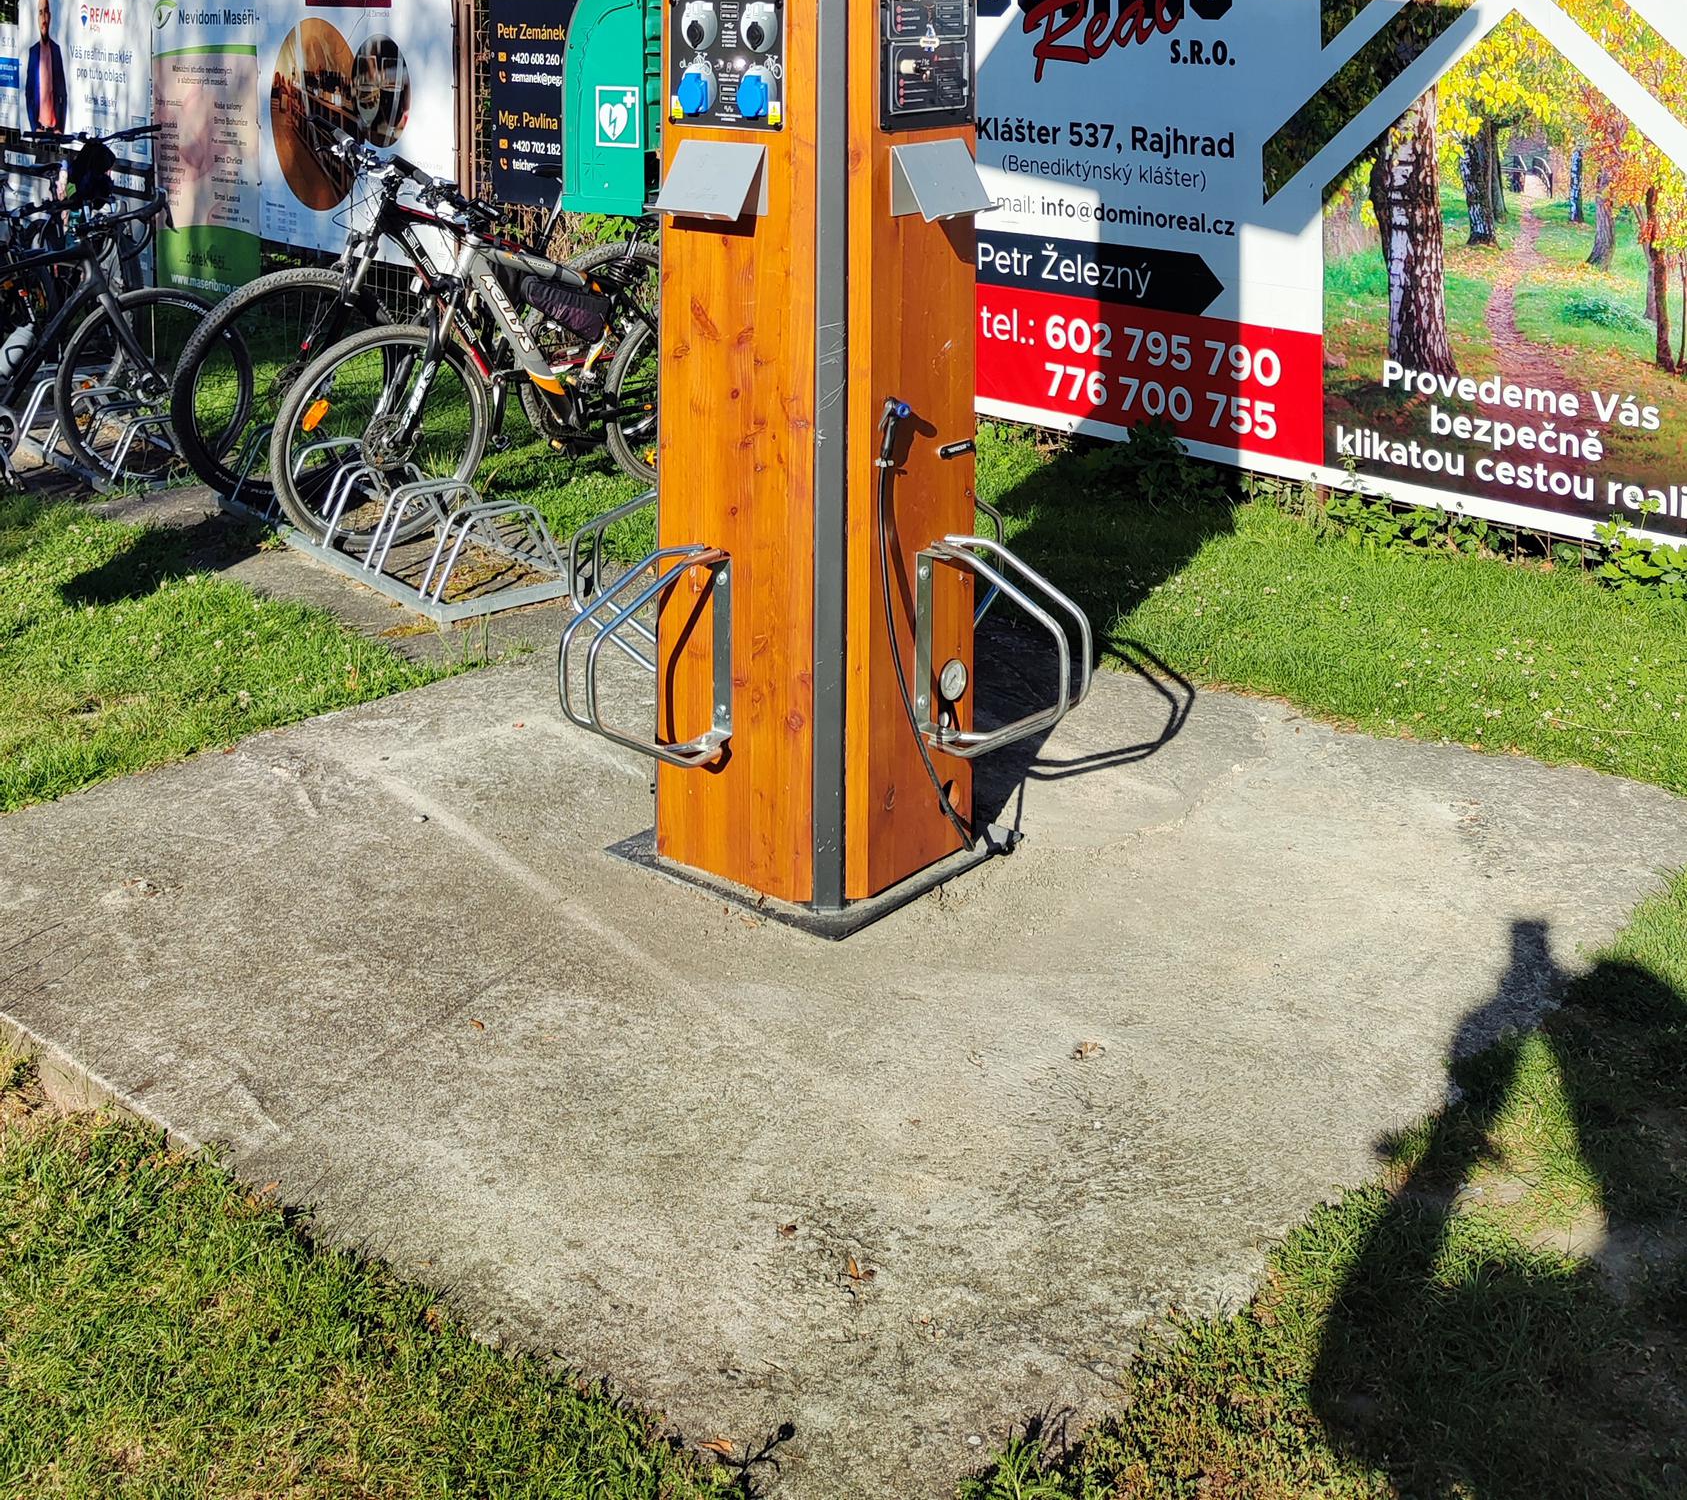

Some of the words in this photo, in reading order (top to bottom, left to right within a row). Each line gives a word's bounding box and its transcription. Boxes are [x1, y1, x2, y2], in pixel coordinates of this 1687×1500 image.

[90, 7, 122, 24] RE/MAX
[178, 8, 221, 26] Nevidomí
[223, 8, 254, 26] Maséři
[497, 23, 518, 39] Petr
[520, 24, 565, 40] Zemánek
[70, 45, 82, 59] Váš
[108, 47, 132, 64] makléř
[511, 52, 530, 65] +420
[530, 54, 544, 65] 608
[546, 54, 560, 66] 260
[1170, 39, 1235, 65] S.R.O.
[76, 68, 87, 80] pro
[104, 69, 126, 83] oblast
[499, 110, 520, 129] Mgr.
[523, 112, 558, 130] Pavlína
[512, 140, 530, 153] +420
[531, 142, 545, 154] 702
[546, 143, 561, 155] 182
[977, 117, 1060, 145] Klášter
[1069, 122, 1123, 153] 537,
[1131, 127, 1234, 159] Rajhrad
[1001, 154, 1132, 186] (Benediktýnský
[1139, 168, 1206, 192] klášter)
[1041, 196, 1235, 237] info@dominoreal.cz
[977, 242, 1032, 277] Petr
[1041, 243, 1151, 298] Železný
[981, 305, 1035, 345] tel.:
[1045, 315, 1112, 358] 602
[1123, 327, 1192, 371] 795
[1204, 340, 1281, 387] 790
[1044, 362, 1108, 405] 776
[1118, 376, 1193, 422] 700
[1206, 391, 1277, 440] 755
[1382, 359, 1579, 417] Provedeme
[1591, 390, 1661, 430] Vás
[1430, 405, 1604, 461] bezpečně
[1336, 425, 1465, 477] klikatou
[1475, 457, 1595, 501] cestou
